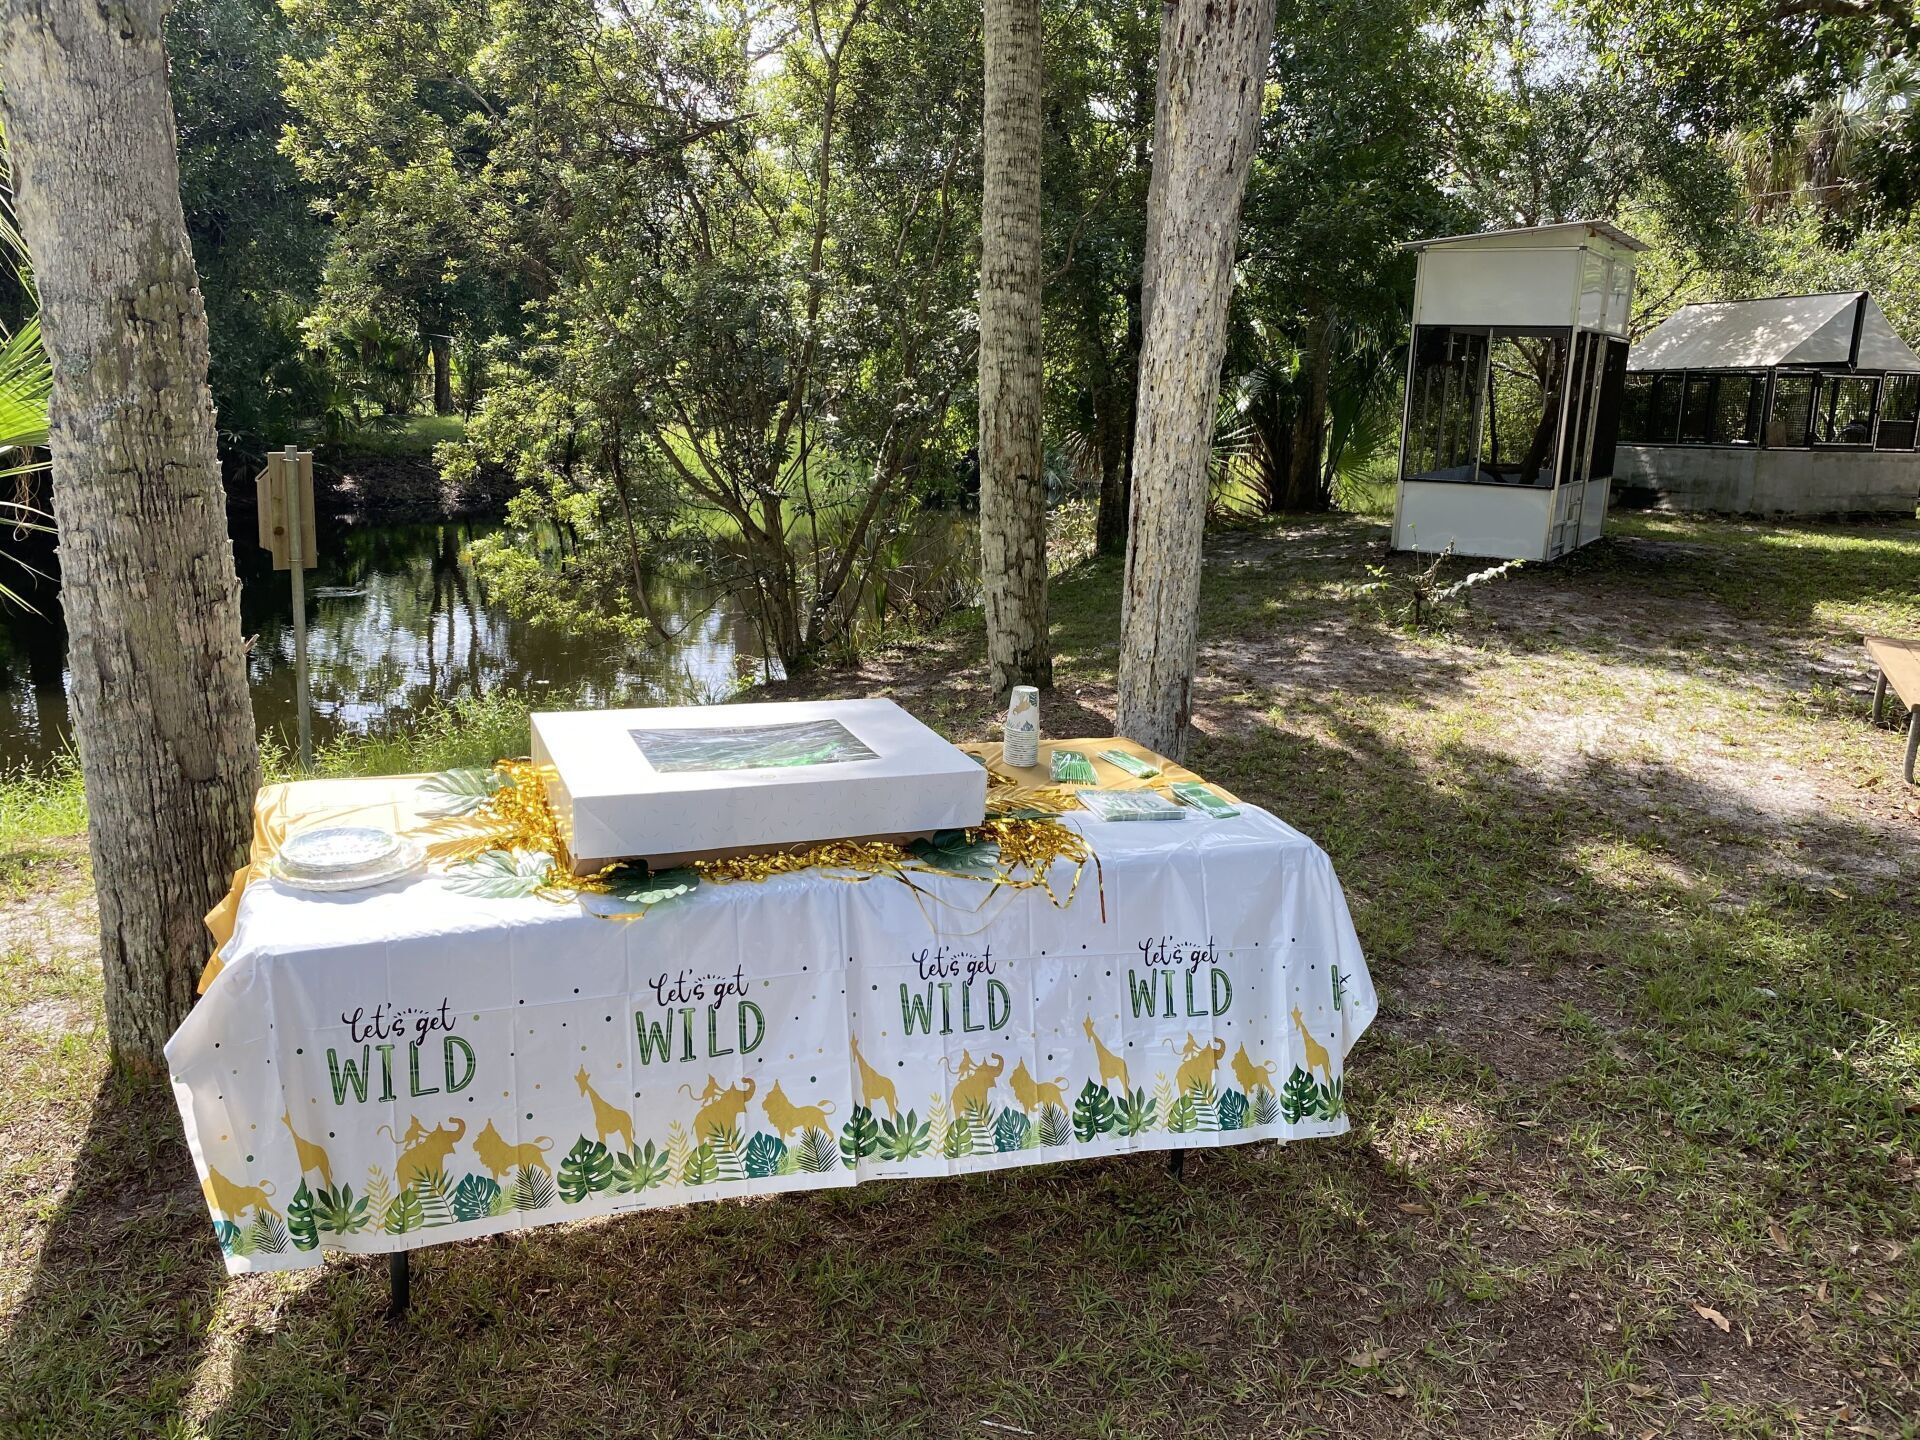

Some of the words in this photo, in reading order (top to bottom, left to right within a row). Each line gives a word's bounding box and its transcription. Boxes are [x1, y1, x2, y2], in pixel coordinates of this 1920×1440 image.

[967, 945, 996, 986] get
[1191, 936, 1219, 973] get
[714, 964, 749, 1009] get
[900, 979, 1010, 1035] WILD
[1129, 968, 1232, 1018] WILD
[416, 997, 456, 1046] get
[635, 1001, 765, 1065] WILD
[326, 1036, 476, 1105] WILD
